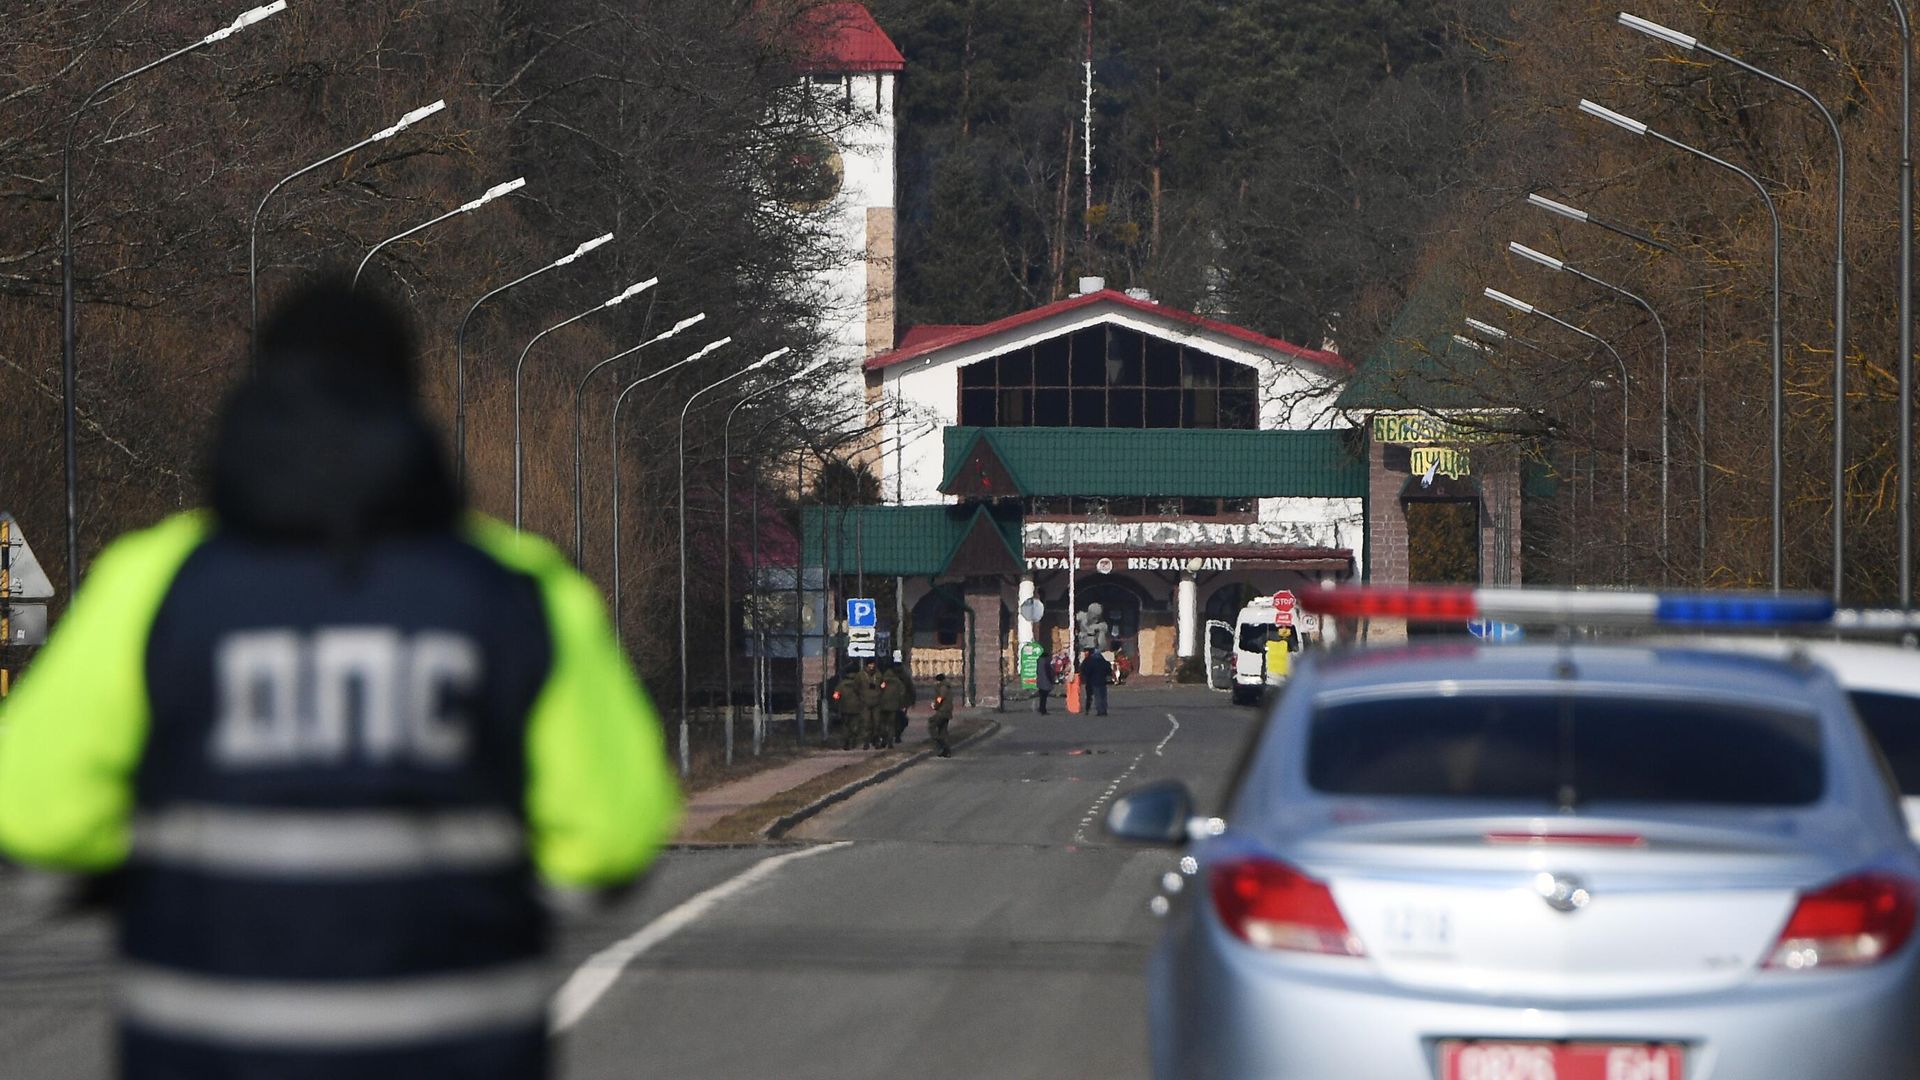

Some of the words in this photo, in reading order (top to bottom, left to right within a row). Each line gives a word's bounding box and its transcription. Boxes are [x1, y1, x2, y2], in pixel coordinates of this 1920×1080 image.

[1127, 556, 1234, 571] RESTAUANT
[1274, 597, 1294, 606] STOP
[854, 602, 872, 625] P
[210, 626, 481, 766] ДПС
